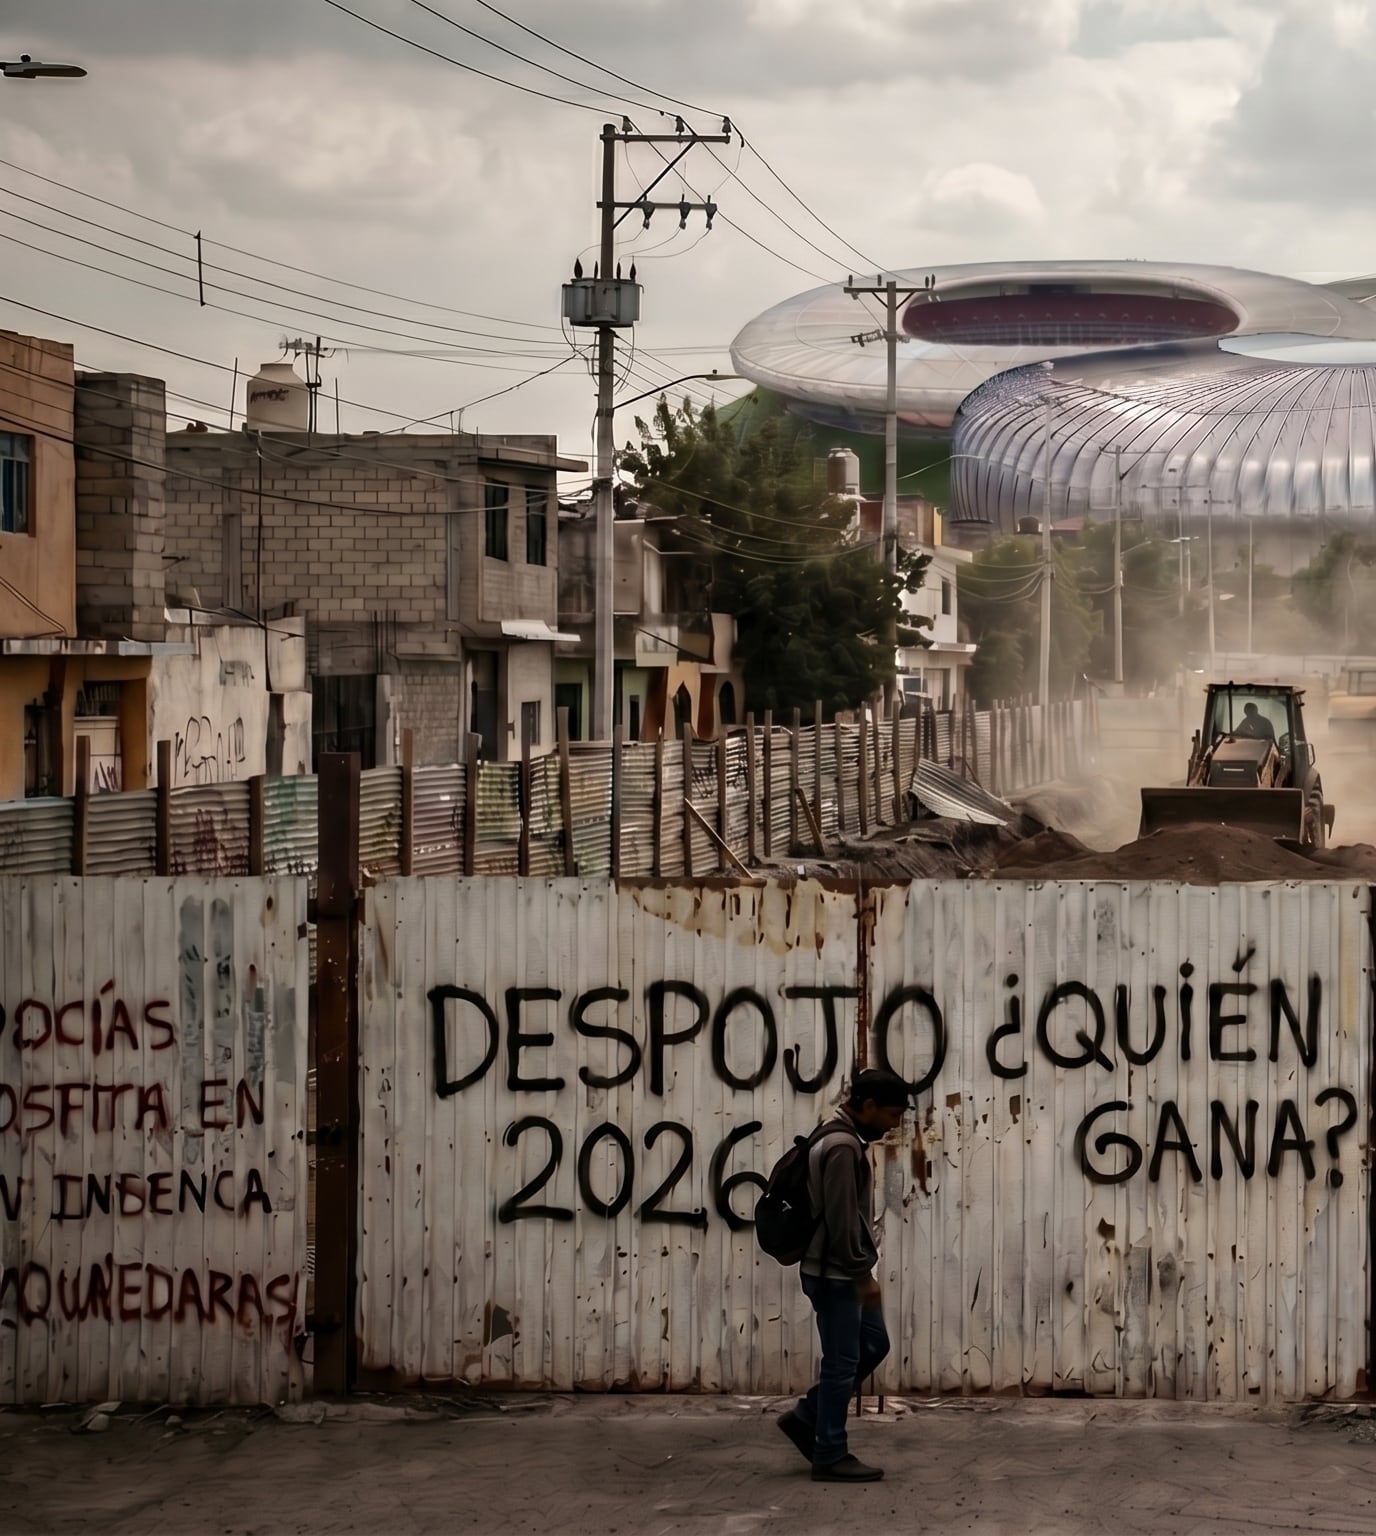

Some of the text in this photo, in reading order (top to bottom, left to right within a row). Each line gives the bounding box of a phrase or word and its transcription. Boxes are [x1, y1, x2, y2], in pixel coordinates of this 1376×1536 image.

[427, 980, 947, 1099] DESPOJO
[984, 943, 1322, 1079] ¿QUIÉN
[200, 1079, 264, 1132] EN
[1075, 1088, 1357, 1188] GANA?
[498, 1115, 768, 1231] 2026
